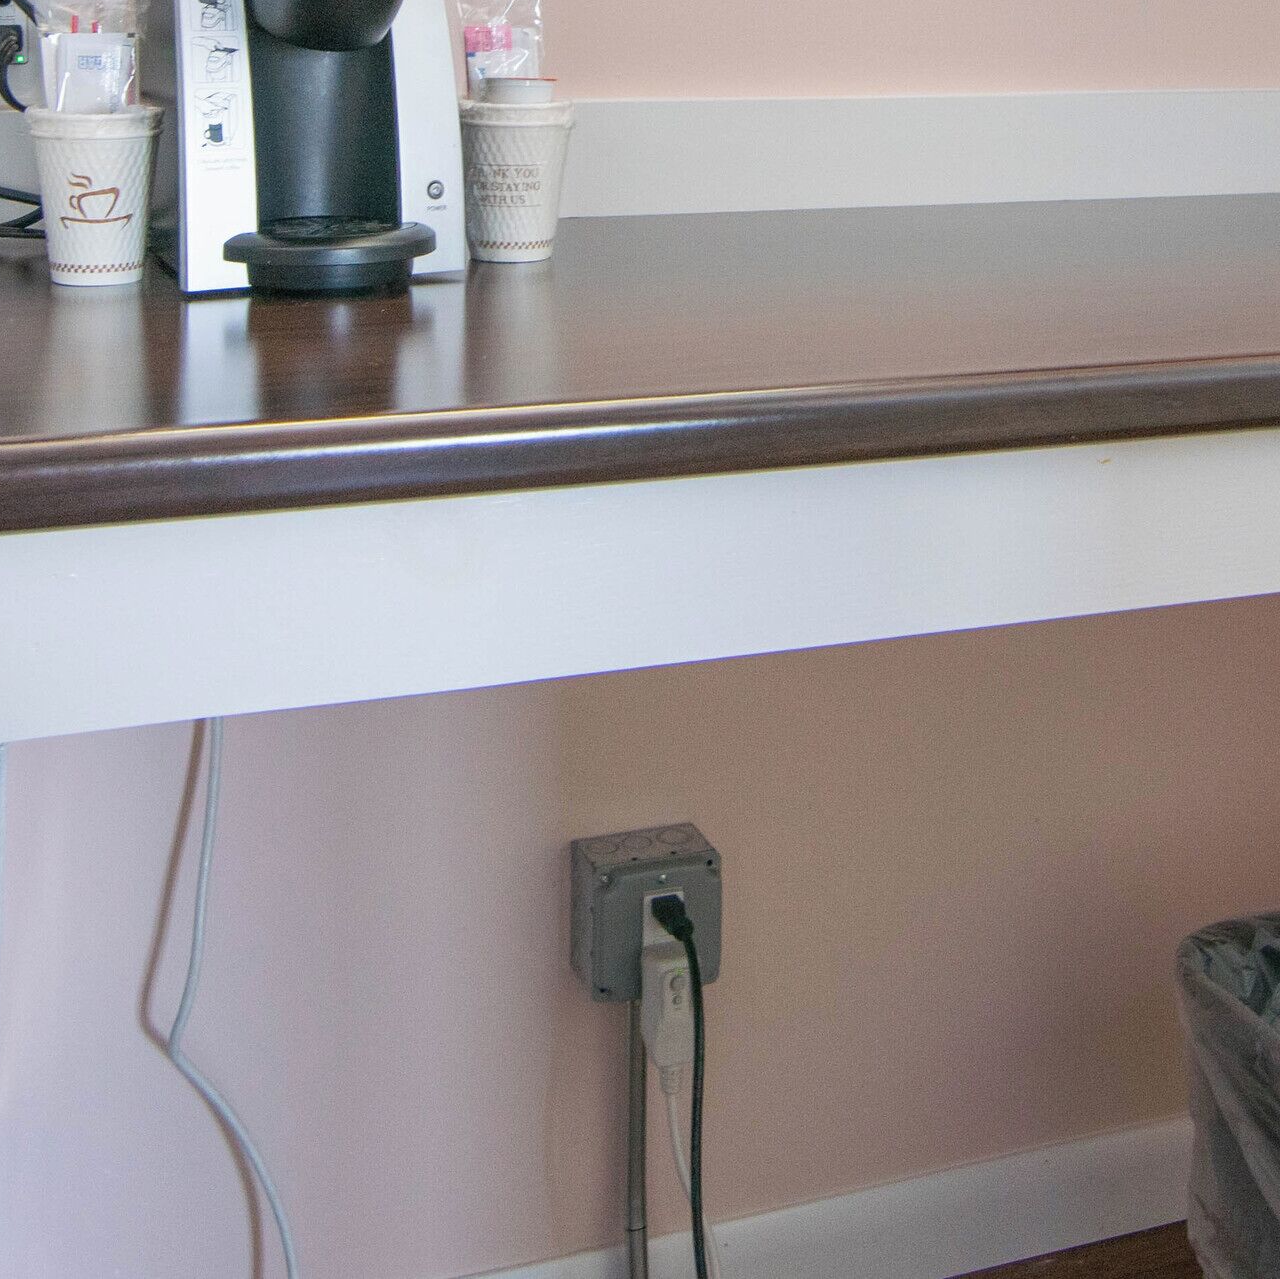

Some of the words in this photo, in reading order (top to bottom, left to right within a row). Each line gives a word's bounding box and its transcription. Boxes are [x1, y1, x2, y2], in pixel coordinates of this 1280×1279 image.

[514, 167, 540, 179] YOU
[491, 181, 541, 192] STAYING
[510, 195, 526, 204] US
